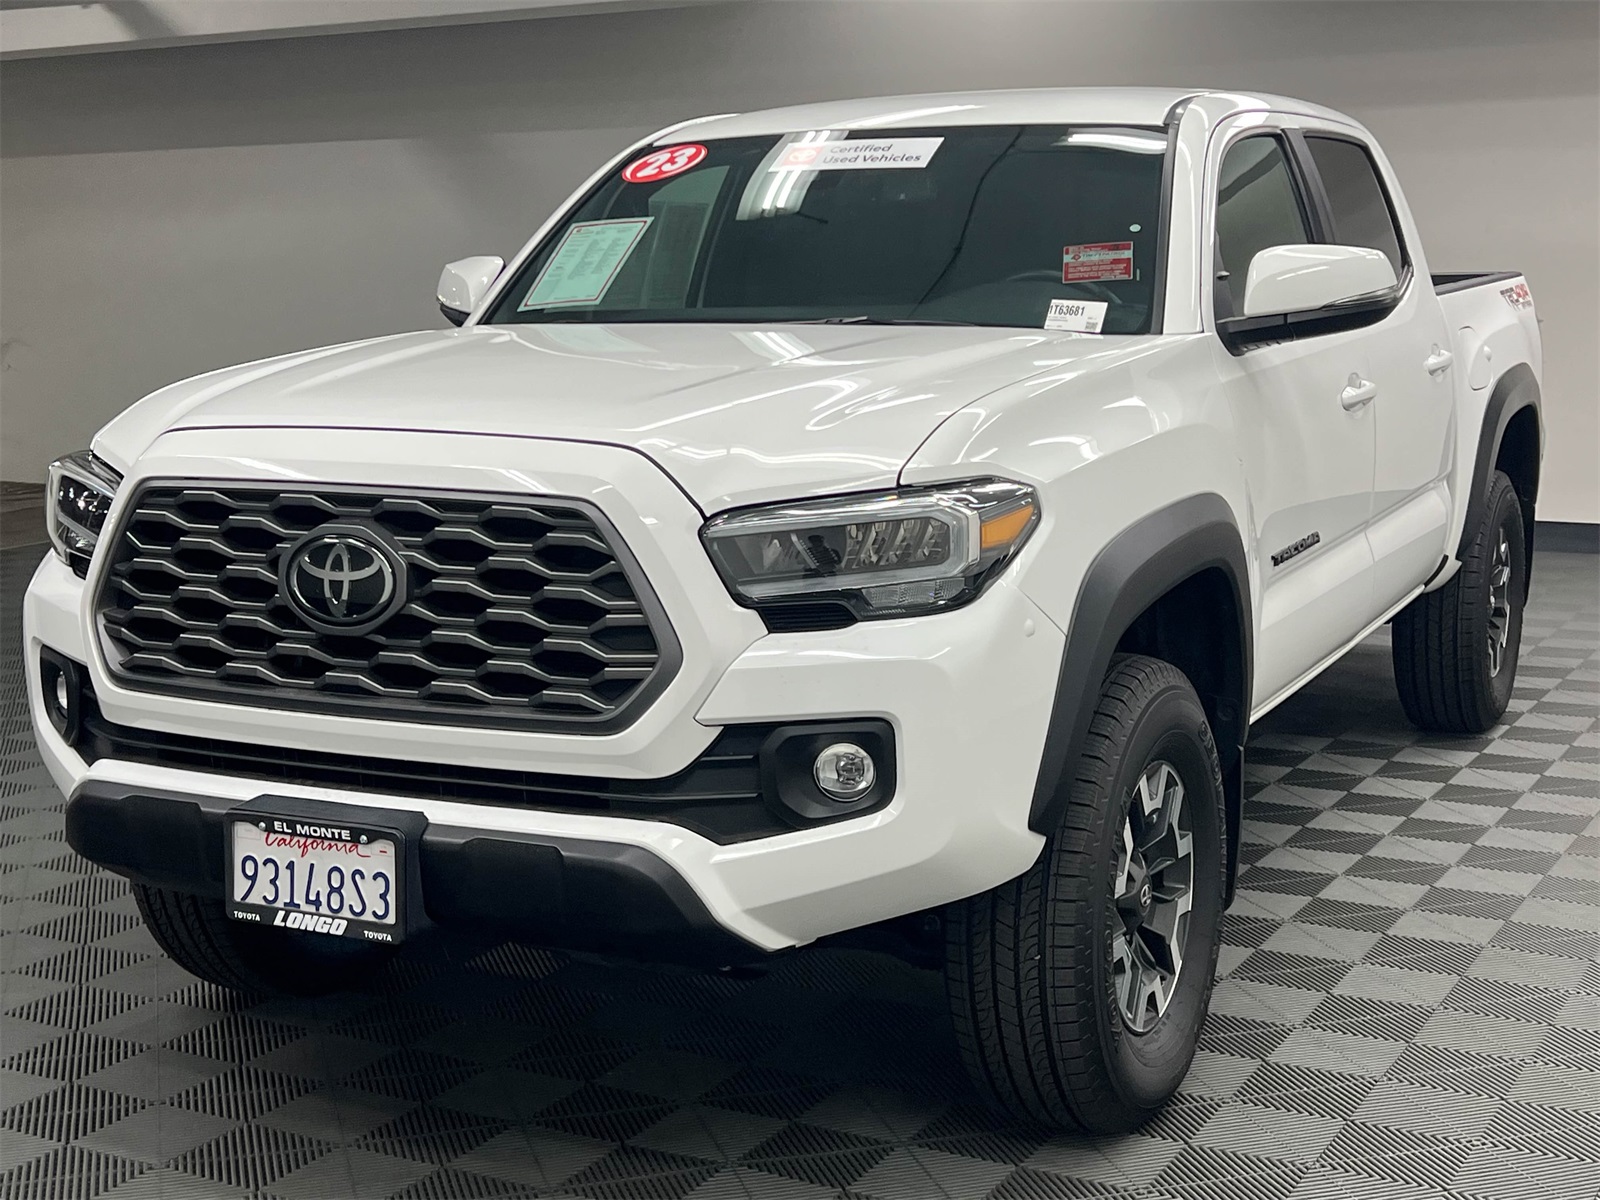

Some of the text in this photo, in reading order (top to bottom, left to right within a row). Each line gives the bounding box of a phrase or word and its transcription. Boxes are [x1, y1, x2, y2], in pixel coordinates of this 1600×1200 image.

[823, 154, 922, 164] Used Vehicles
[830, 144, 893, 154] Certified
[635, 147, 697, 178] 23
[273, 821, 351, 840] EL MONTE
[240, 854, 391, 920] 93148S3
[233, 910, 393, 942] TOYOTA LONGO TOYOTA
